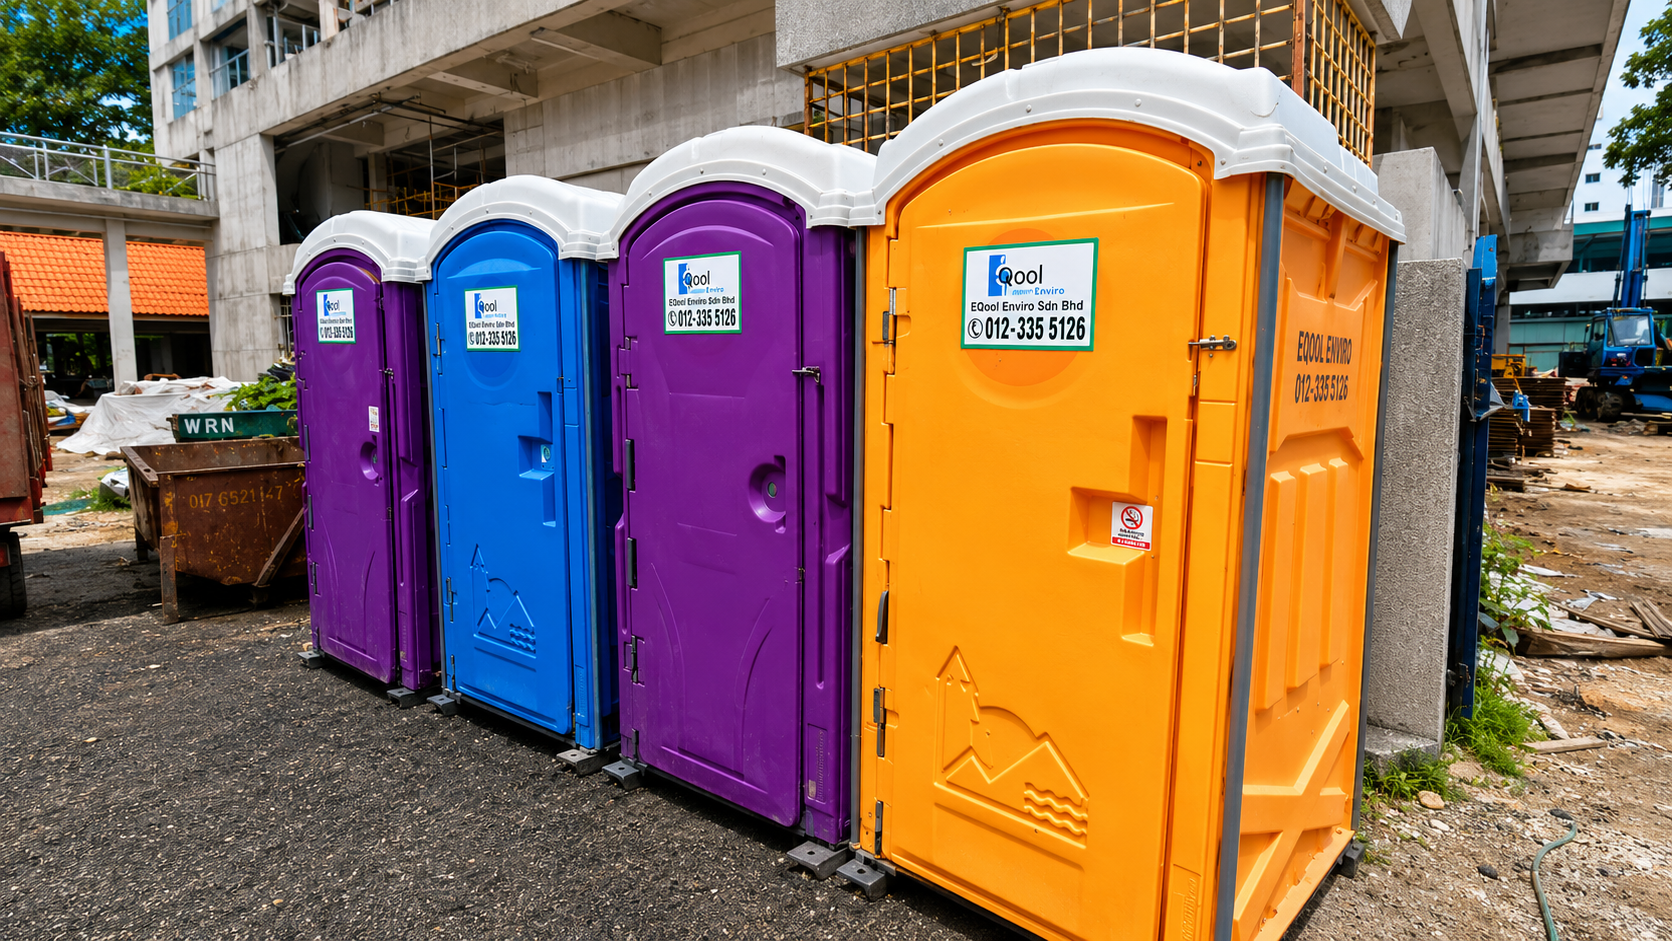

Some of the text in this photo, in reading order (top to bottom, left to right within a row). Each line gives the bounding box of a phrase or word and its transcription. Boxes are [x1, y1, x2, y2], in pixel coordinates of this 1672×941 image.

[1034, 286, 1065, 295] Enviro
[708, 296, 721, 305] Sdn
[971, 300, 1084, 312] EQool Enviro Sdn Bhd
[678, 307, 736, 328] 012-335 5126
[985, 316, 1086, 340] 012-335 5126
[500, 330, 517, 346] 5126
[1297, 330, 1352, 366] EQOOL ENVIRO
[1295, 373, 1349, 404] 012-335 5126
[184, 417, 235, 434] WRN
